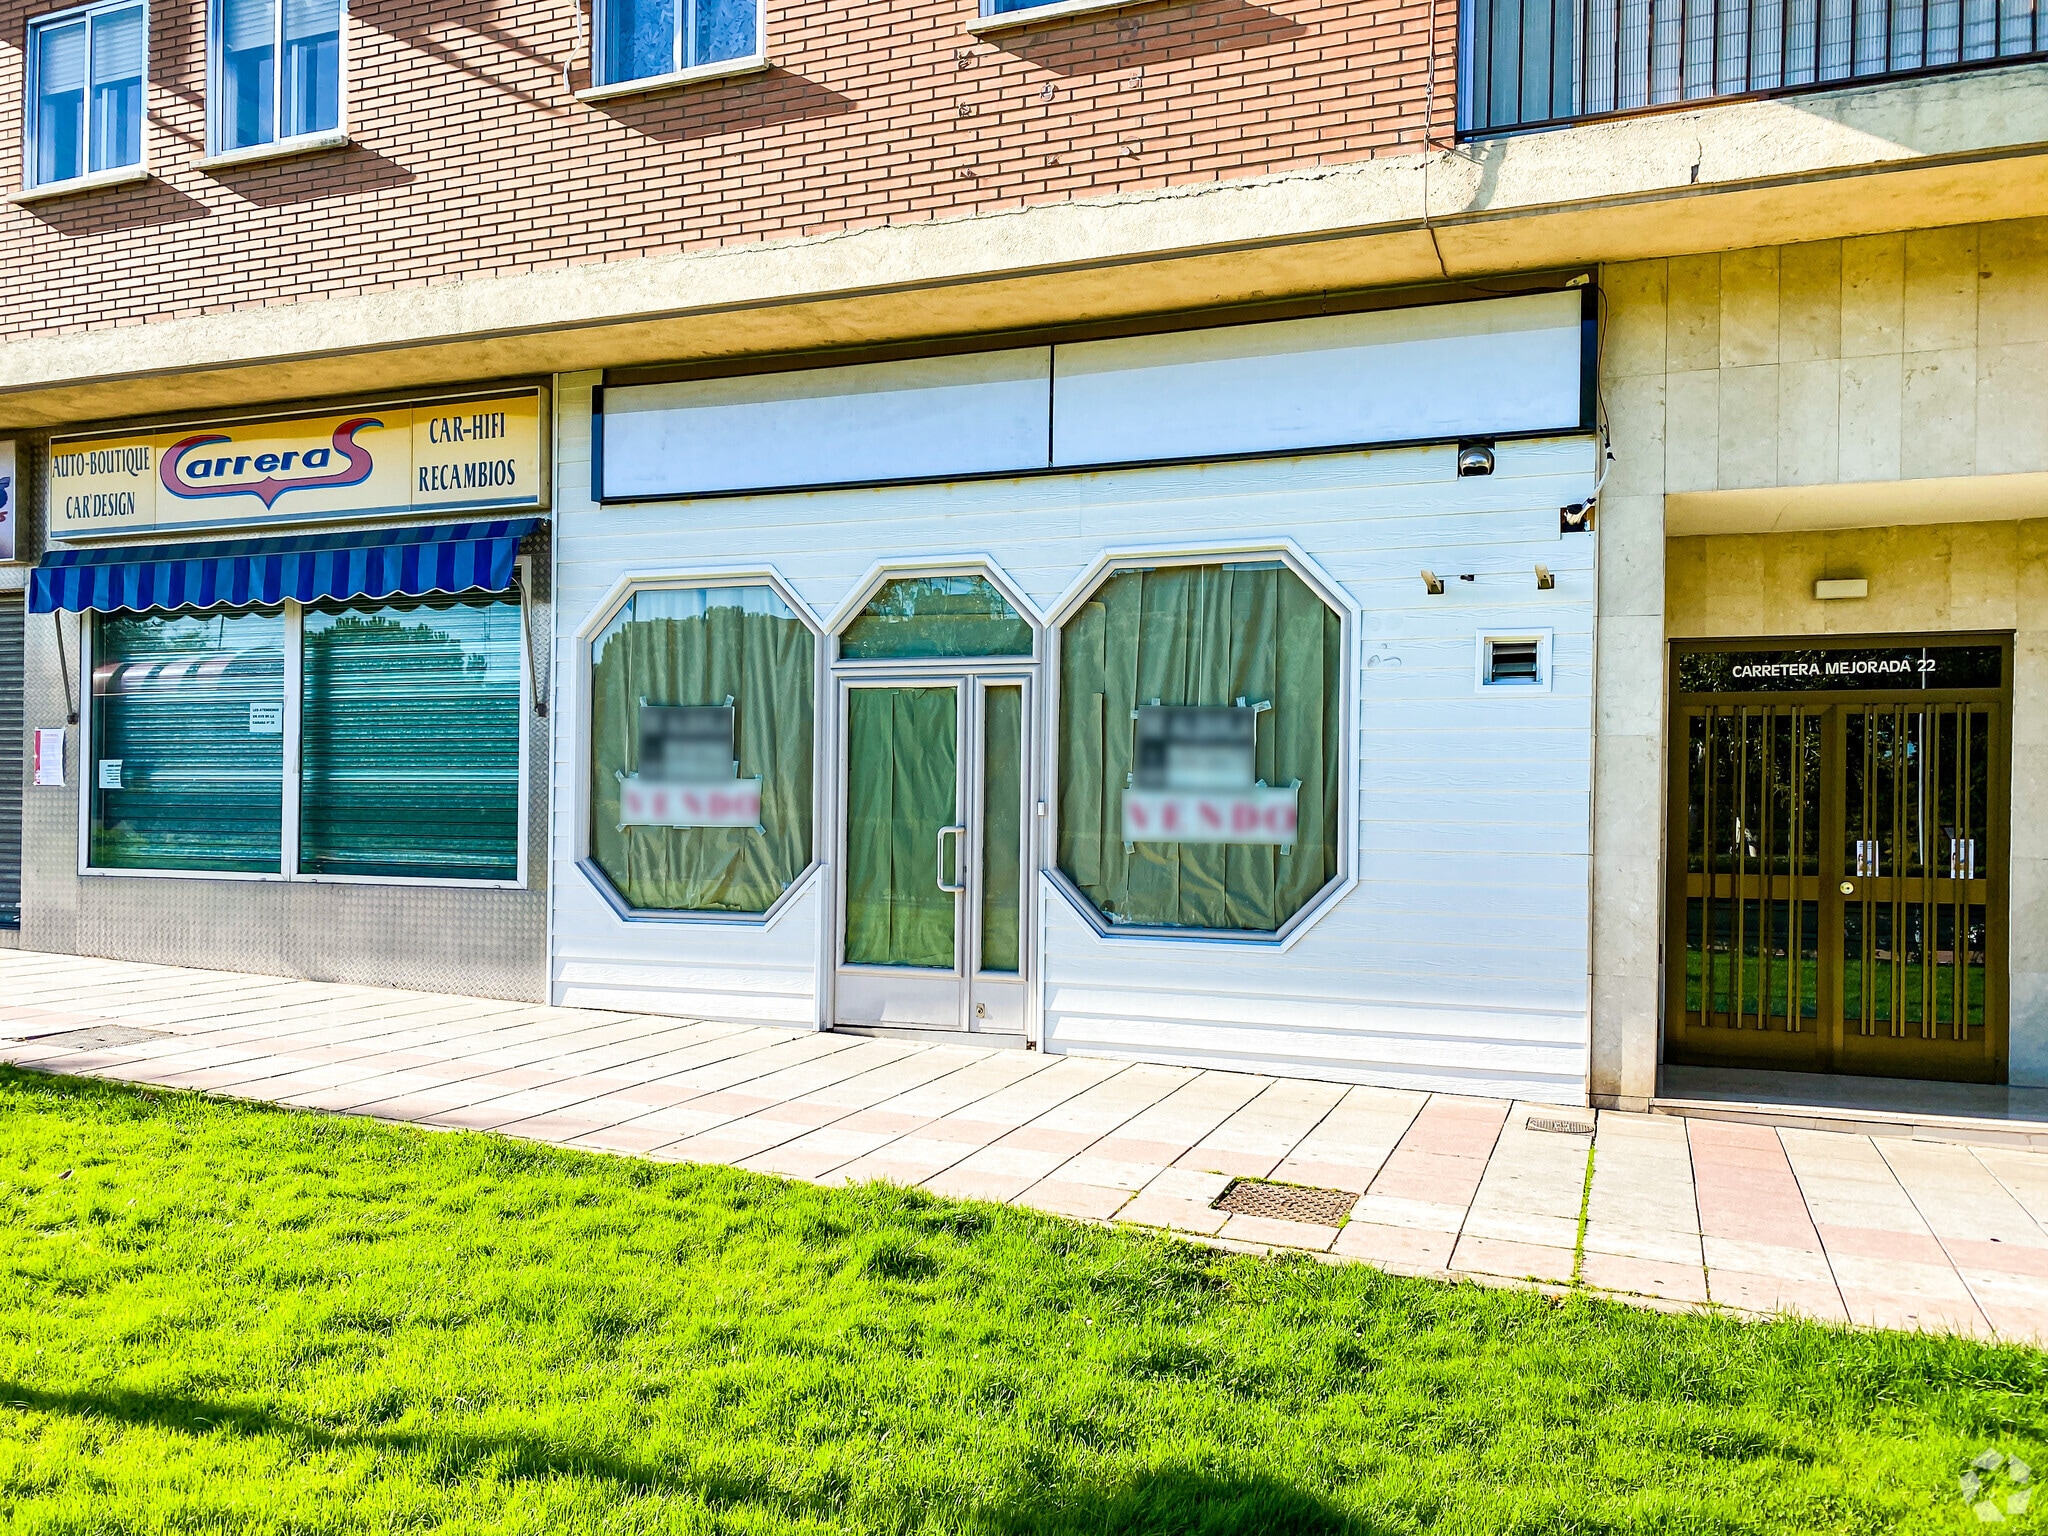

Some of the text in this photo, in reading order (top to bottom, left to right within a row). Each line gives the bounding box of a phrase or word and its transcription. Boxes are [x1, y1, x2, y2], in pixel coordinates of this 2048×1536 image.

[429, 412, 505, 444] CAR-HIFI
[52, 447, 150, 478] AUTO-BOUTIQUE
[418, 459, 516, 492] RECAMBIOS
[1732, 659, 1936, 678] CARRETERA MEJORADA 22
